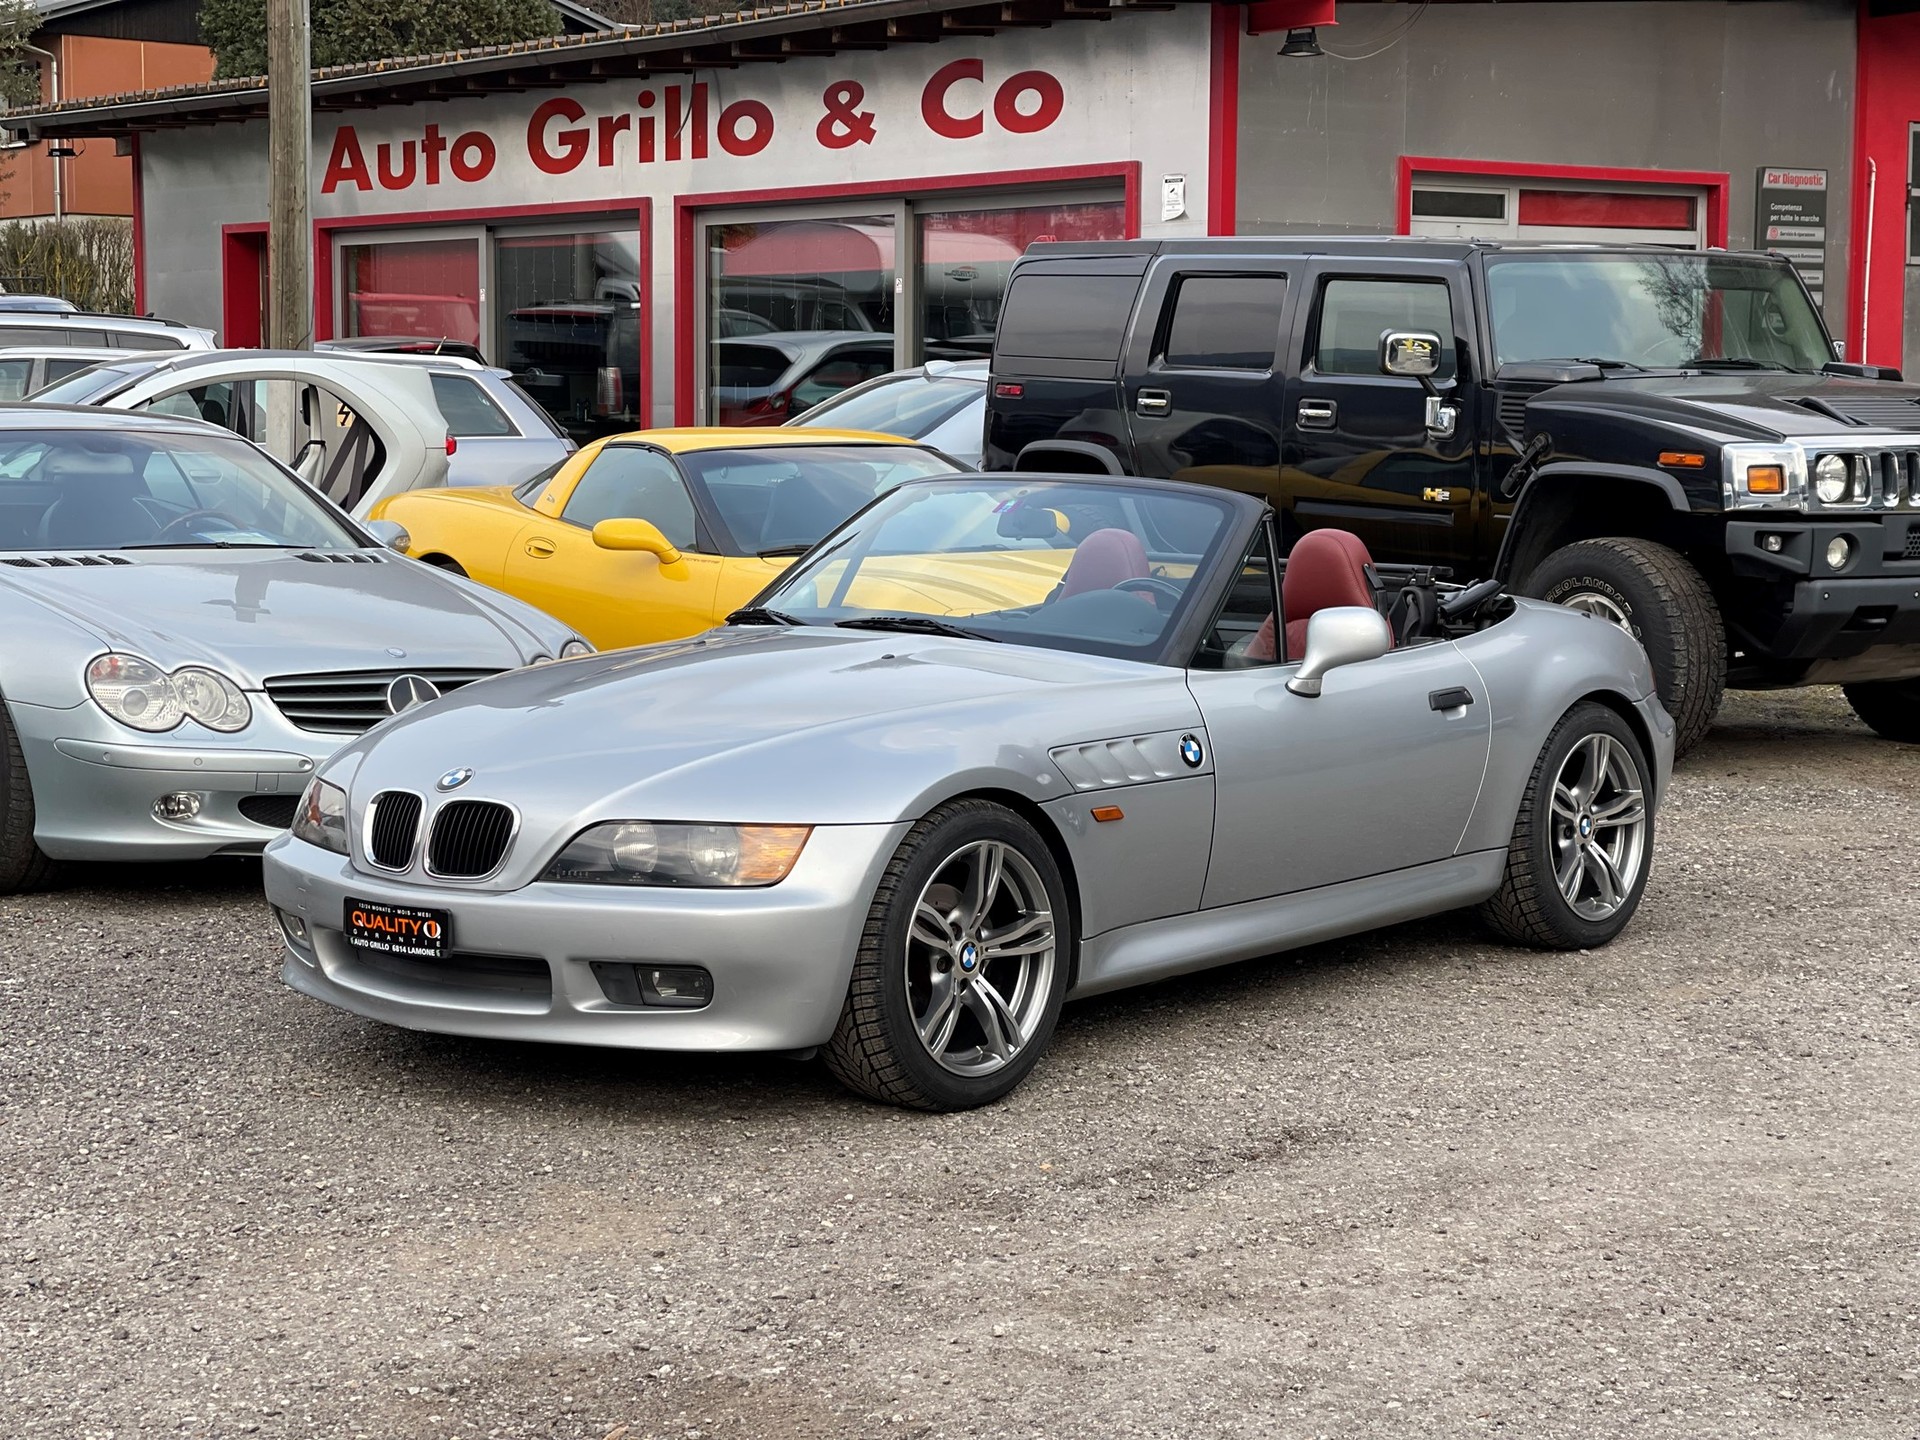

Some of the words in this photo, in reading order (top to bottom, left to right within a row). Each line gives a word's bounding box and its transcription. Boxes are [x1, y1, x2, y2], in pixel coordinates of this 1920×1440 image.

[321, 123, 496, 194] Auto
[526, 82, 774, 174] Grillo
[816, 79, 877, 149] &
[921, 58, 1064, 139] Co
[1768, 173, 1781, 184] Car
[1782, 172, 1823, 187] Diagnostic
[1770, 203, 1802, 211] Competenza
[1423, 487, 1450, 501] H2
[372, 905, 391, 913] MONATE
[352, 910, 422, 936] QUALITY
[354, 938, 369, 947] AUTO
[370, 940, 390, 951] GRILLO
[392, 944, 407, 953] 6814
[408, 946, 435, 957] LAMONE
